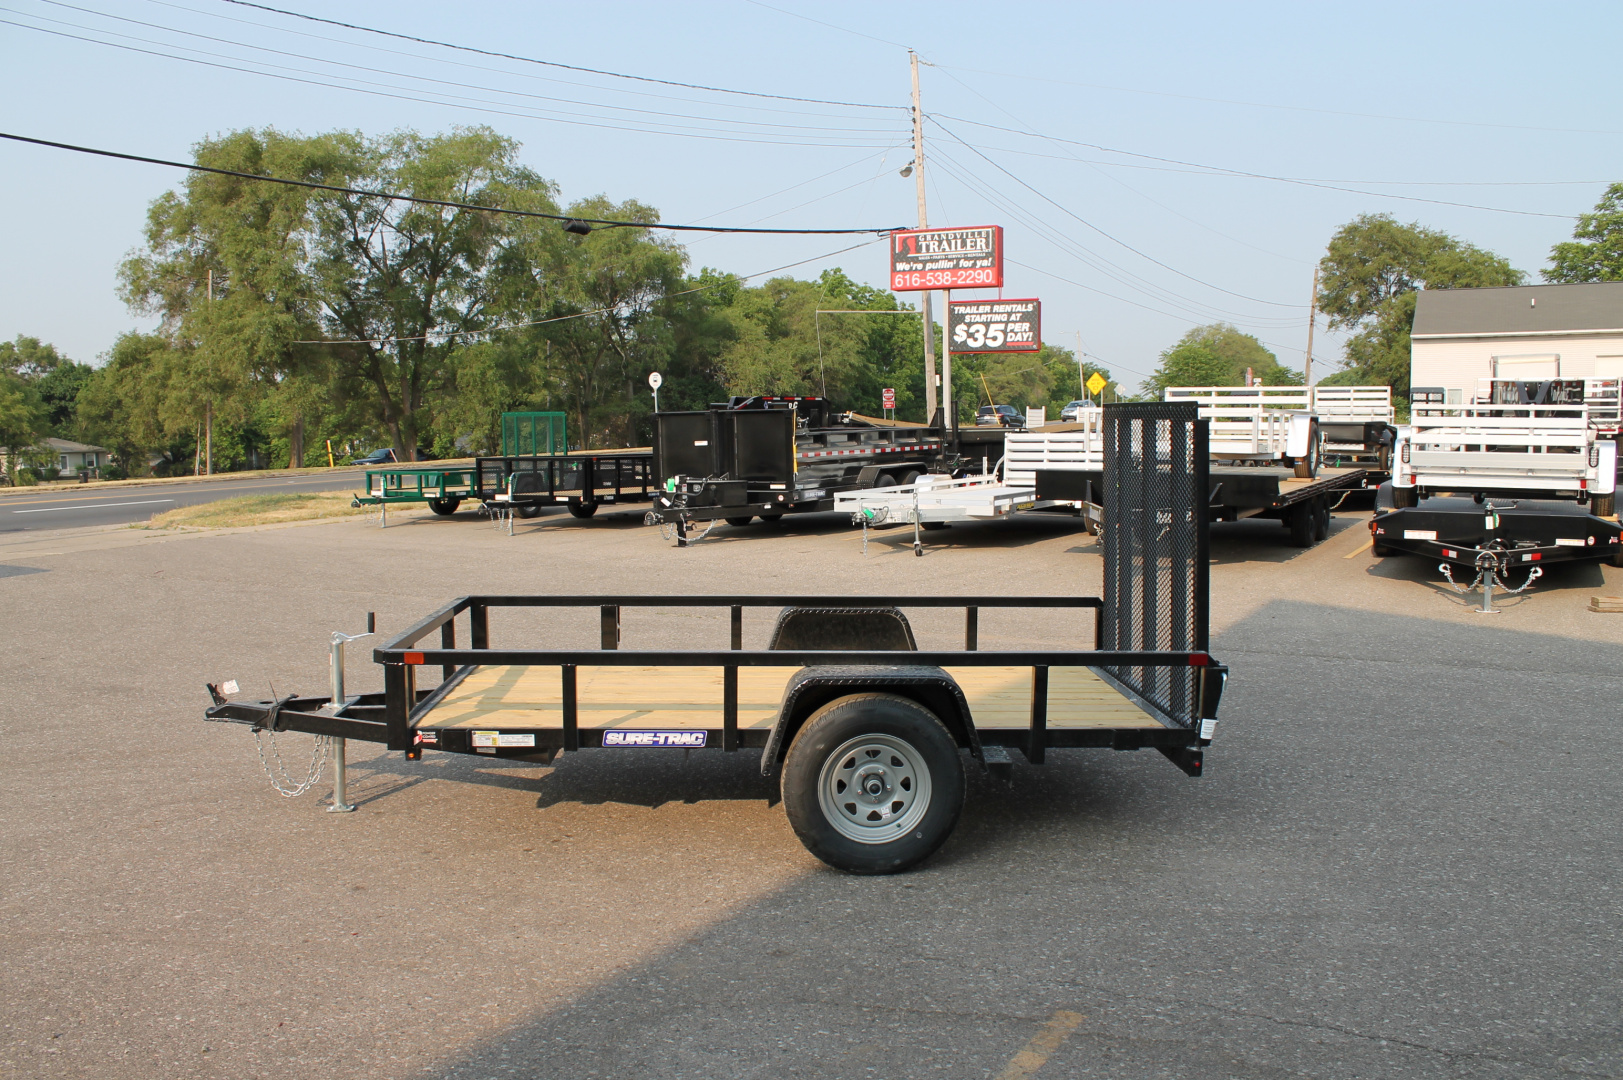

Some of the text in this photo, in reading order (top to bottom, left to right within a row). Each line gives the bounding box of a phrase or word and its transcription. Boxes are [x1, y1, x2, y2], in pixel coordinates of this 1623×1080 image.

[919, 231, 987, 241] GRANDVILLE
[919, 238, 987, 253] TRAILER
[896, 257, 992, 271] We're pullin' for ya!
[895, 270, 992, 287] 616-538-2290
[953, 304, 1033, 314] TRAILER RENTALS
[964, 313, 1023, 323] STARTING AT
[1006, 322, 1030, 332] PER
[953, 322, 1006, 348] $35
[1006, 332, 1034, 341] DAY!
[605, 733, 704, 745] SURE-TRAC
